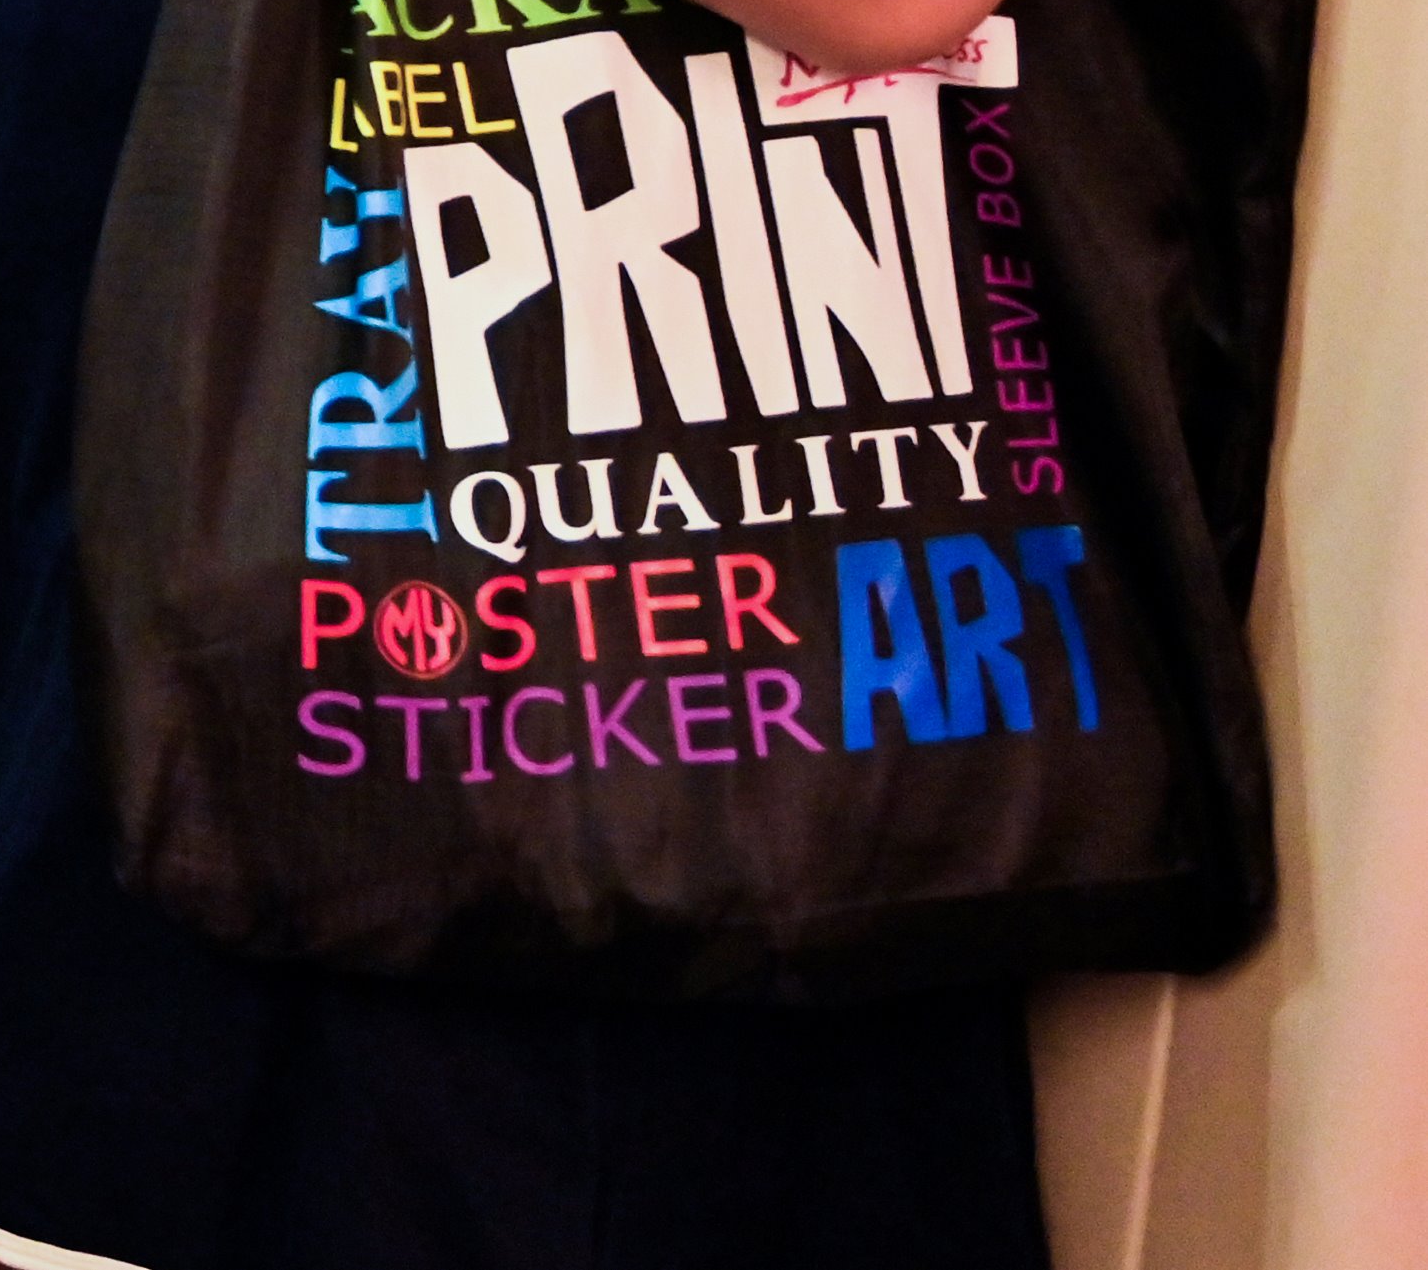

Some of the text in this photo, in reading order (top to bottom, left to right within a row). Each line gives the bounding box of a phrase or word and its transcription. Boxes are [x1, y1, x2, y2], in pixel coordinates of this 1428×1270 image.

[305, 165, 440, 564] TRAY
[403, 15, 1019, 450] PRINT
[960, 97, 1066, 496] SLEEVE BOX
[449, 421, 990, 564] QUALITY
[836, 524, 1100, 752] ART
[297, 667, 827, 784] STICKER
